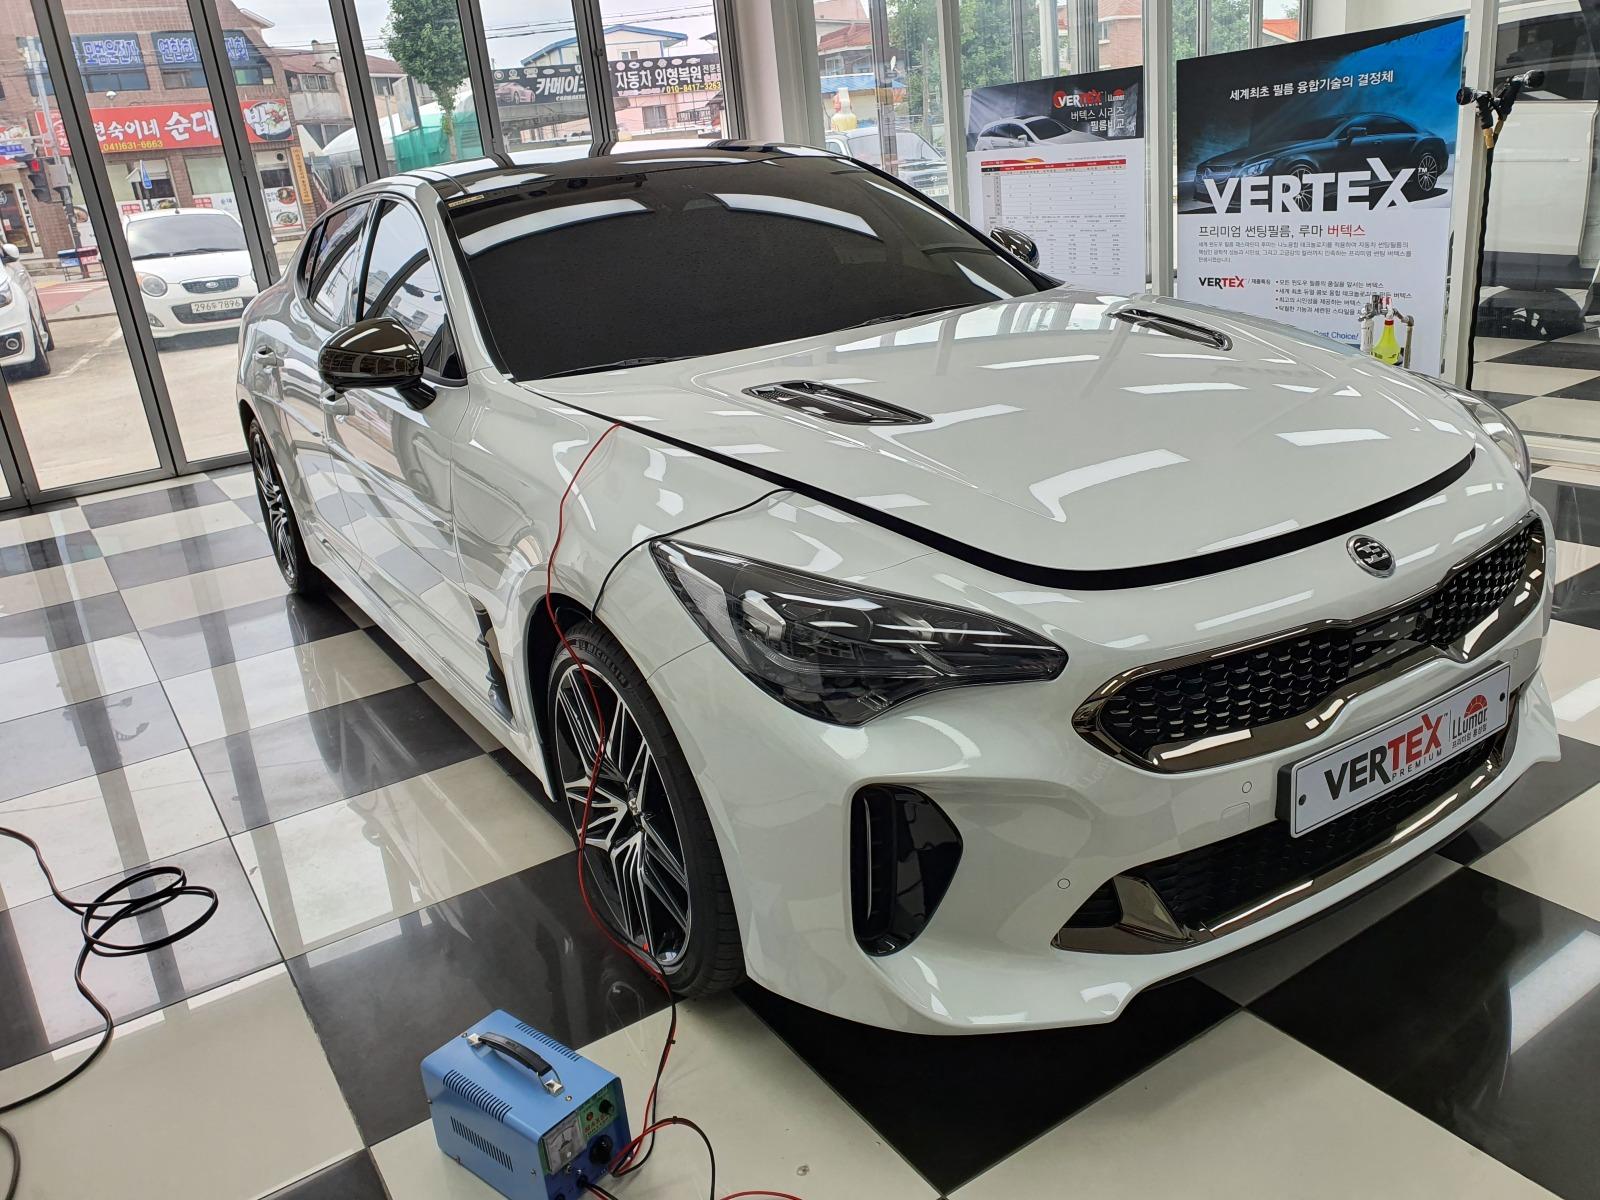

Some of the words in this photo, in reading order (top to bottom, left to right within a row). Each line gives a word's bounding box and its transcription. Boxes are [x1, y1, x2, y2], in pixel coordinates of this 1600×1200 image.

[157, 38, 198, 63] 연합회
[615, 70, 652, 89] 자동차
[655, 65, 703, 87] 외형복원
[1229, 87, 1271, 101] 세계최초
[1273, 84, 1294, 97] 필름
[1296, 75, 1354, 97] 융합기술의
[1357, 69, 1394, 86] 결정체
[1070, 108, 1096, 122] 버텍스
[1098, 105, 1125, 119] 시리즈
[1203, 156, 1416, 215] VERTEX
[1198, 225, 1241, 238] 프리미엄
[1245, 225, 1295, 239] 썬팅필름,
[1299, 225, 1324, 238] 루마
[1327, 224, 1366, 238] 버텍스
[1198, 275, 1245, 290] VERTEX
[1331, 331, 1360, 341] Choice!
[1324, 713, 1443, 800] VERTEX
[1392, 747, 1443, 780] PREMIUM
